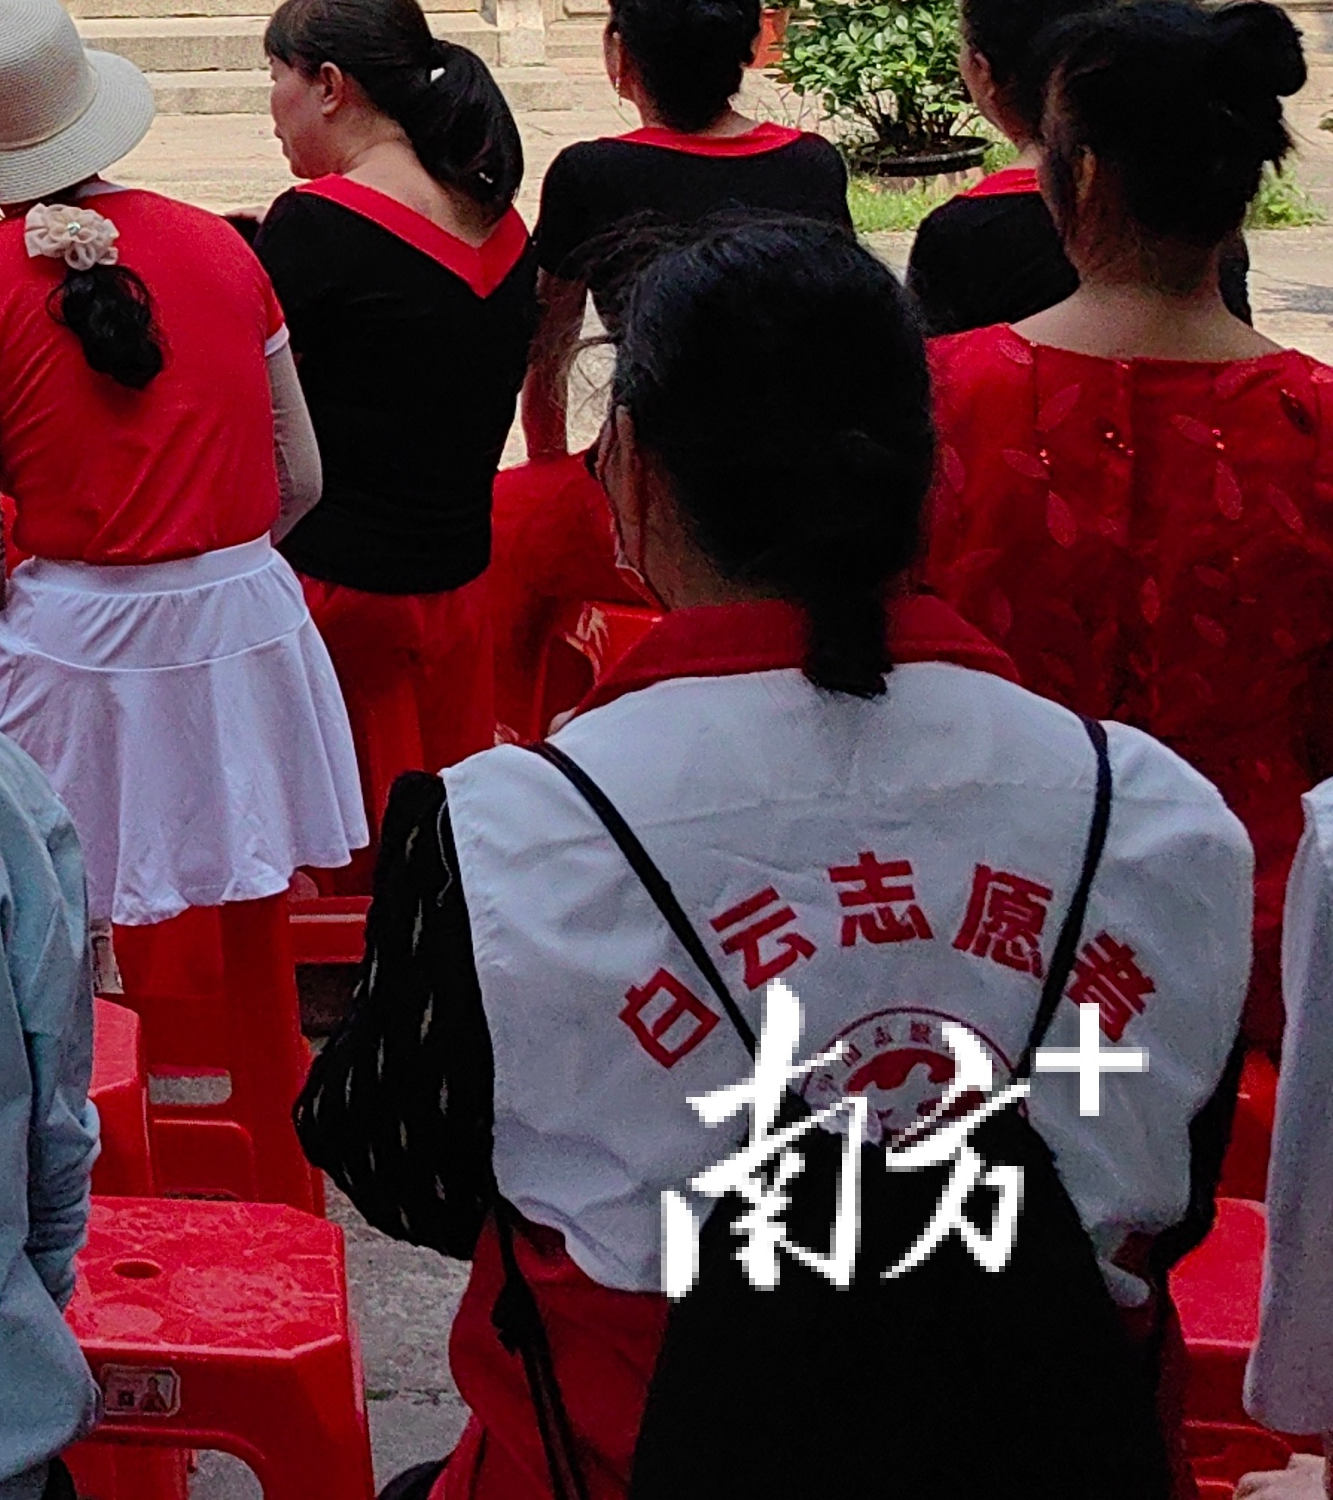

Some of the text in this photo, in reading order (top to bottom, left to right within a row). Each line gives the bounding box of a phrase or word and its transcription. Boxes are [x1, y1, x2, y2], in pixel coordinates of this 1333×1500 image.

[618, 850, 1156, 1069] 白云志愿者
